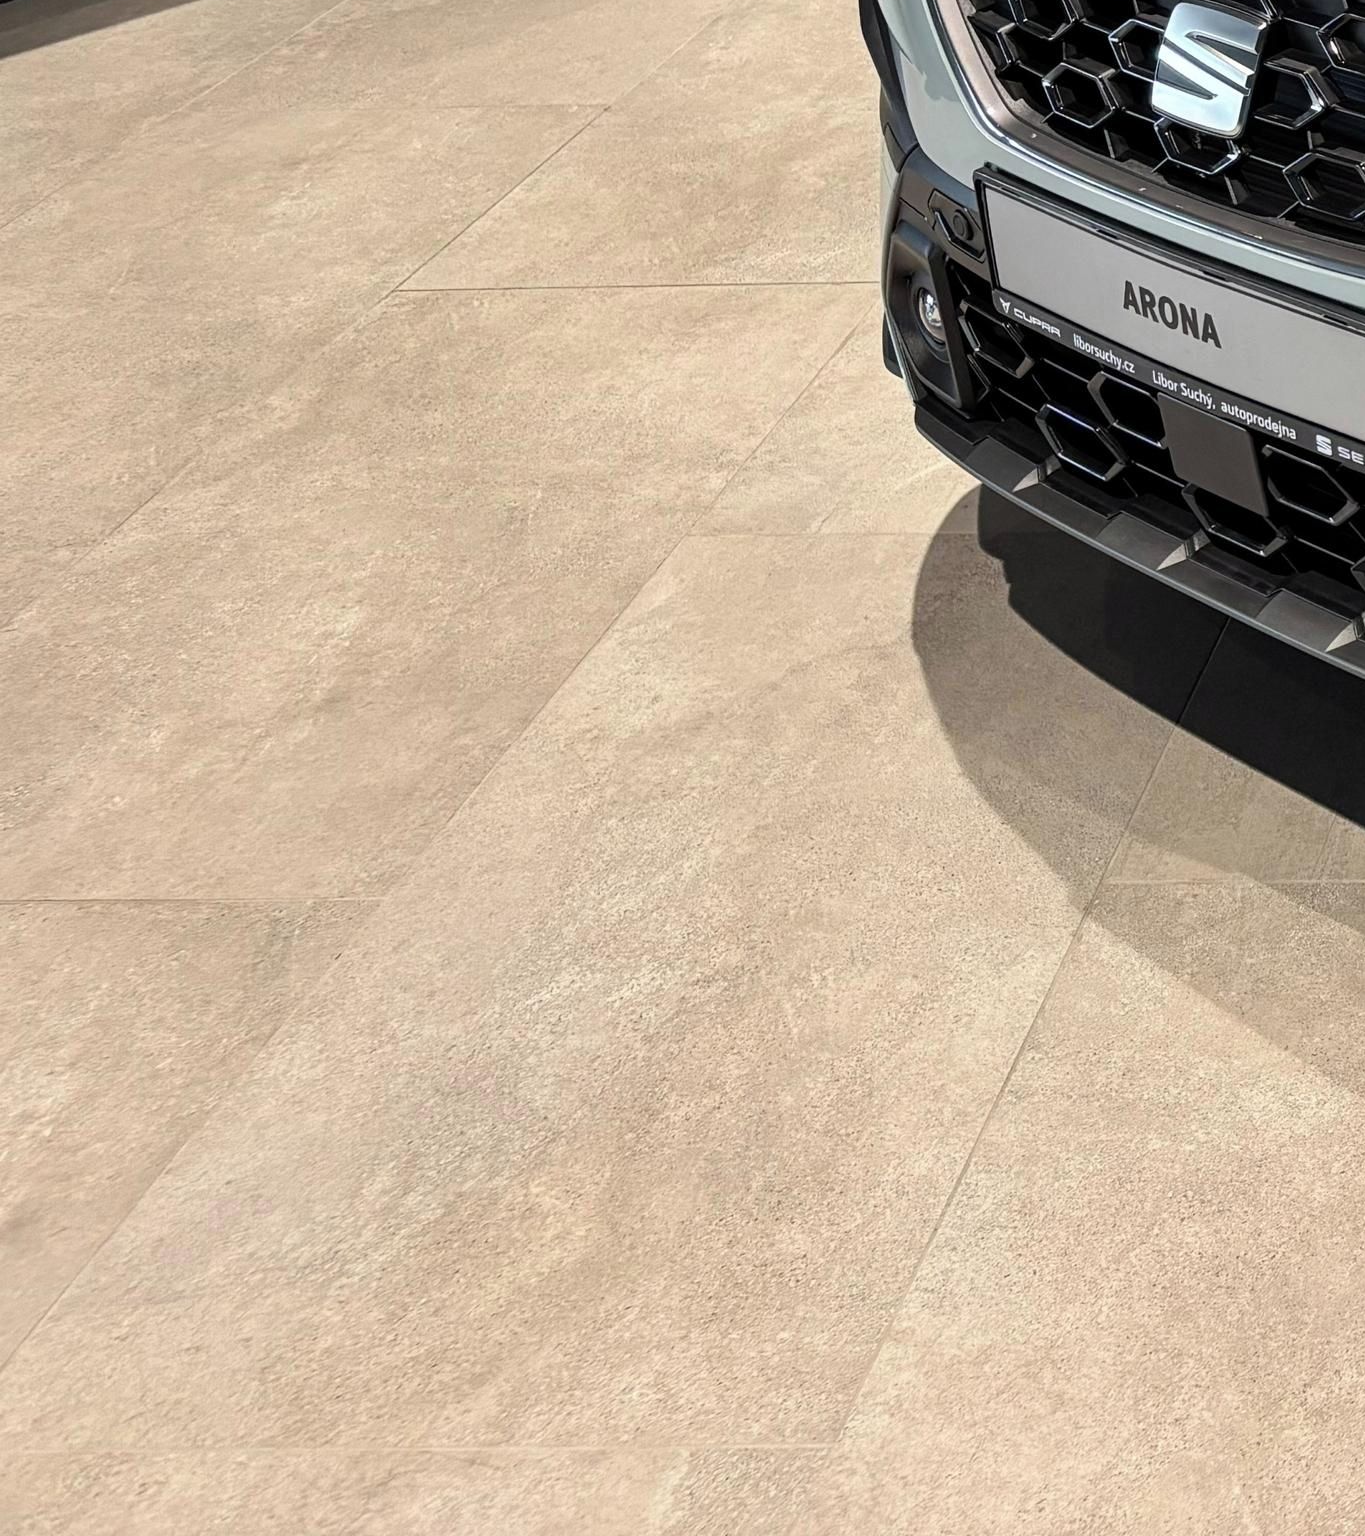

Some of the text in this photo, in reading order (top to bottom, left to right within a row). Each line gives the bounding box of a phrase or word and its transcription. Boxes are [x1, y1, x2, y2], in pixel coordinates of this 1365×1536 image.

[1123, 280, 1222, 349] ARONA
[1014, 307, 1061, 338] CUPRA
[1073, 333, 1136, 373] liborsuchy.cz
[1152, 369, 1178, 393] Libor
[1180, 383, 1216, 410] Suchý,
[1220, 400, 1297, 440] autoprodejna
